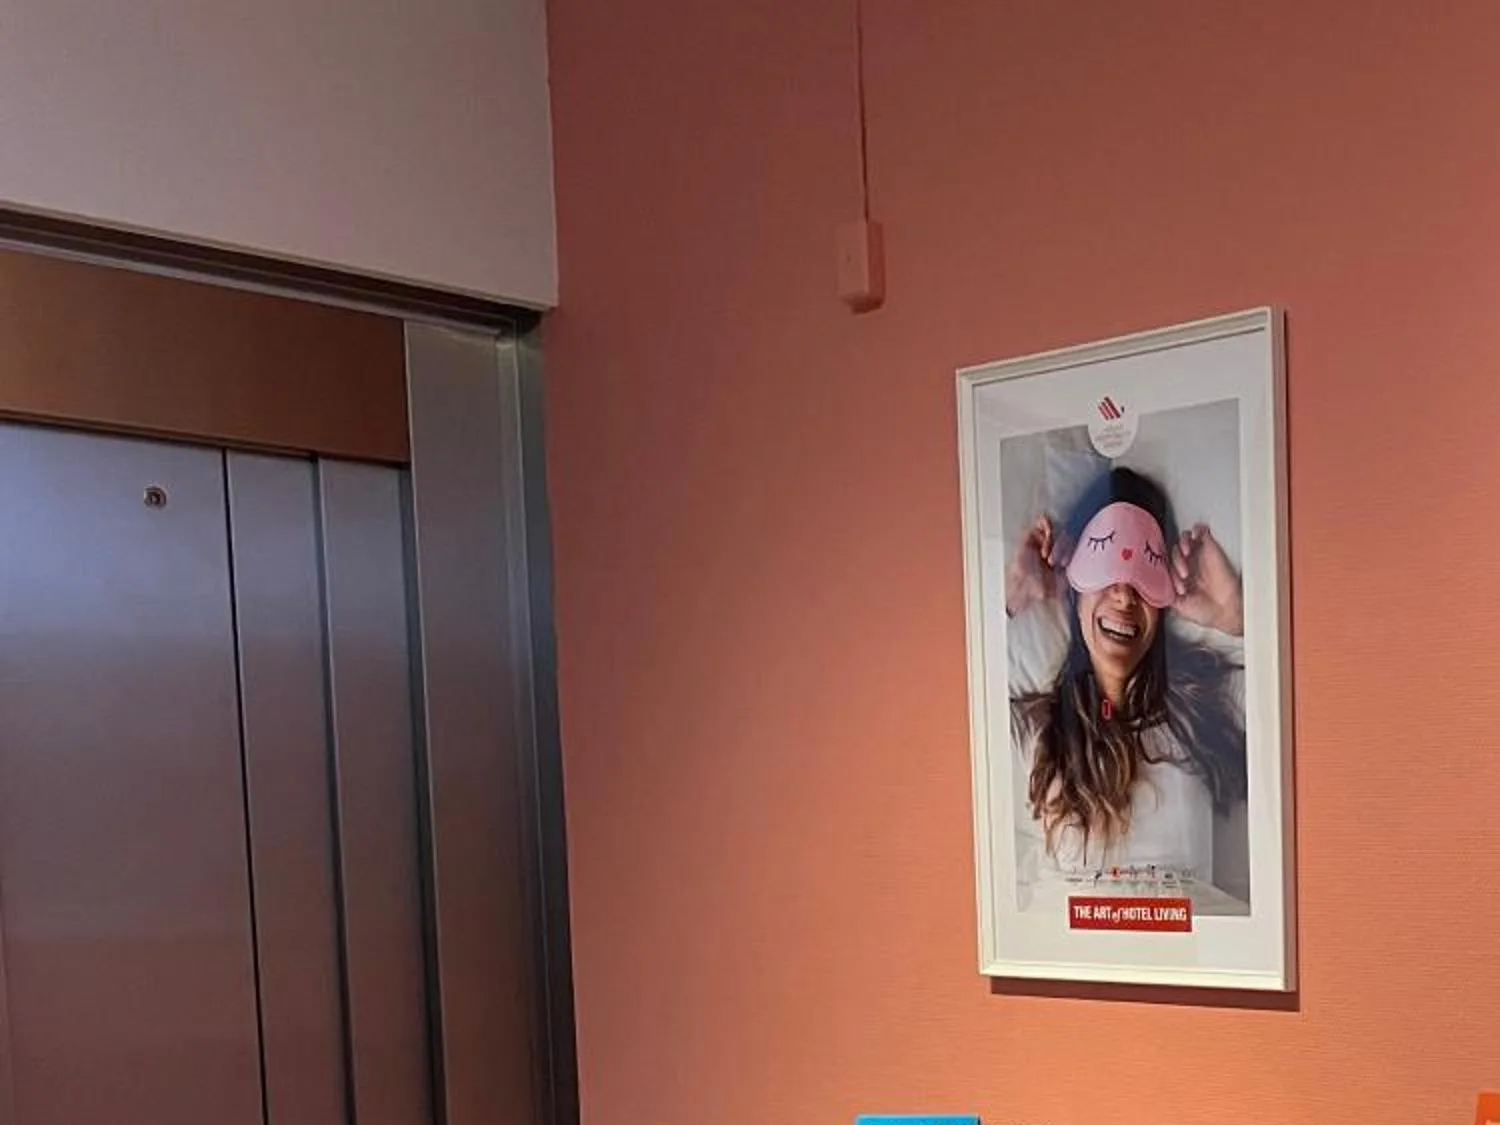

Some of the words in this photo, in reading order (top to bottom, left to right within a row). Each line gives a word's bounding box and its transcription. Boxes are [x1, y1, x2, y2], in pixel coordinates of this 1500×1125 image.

[1073, 905, 1092, 919] THE
[1094, 905, 1111, 920] ART
[1111, 907, 1123, 923] of
[1123, 907, 1153, 921] HOTEL
[1154, 907, 1188, 922] LIVING
